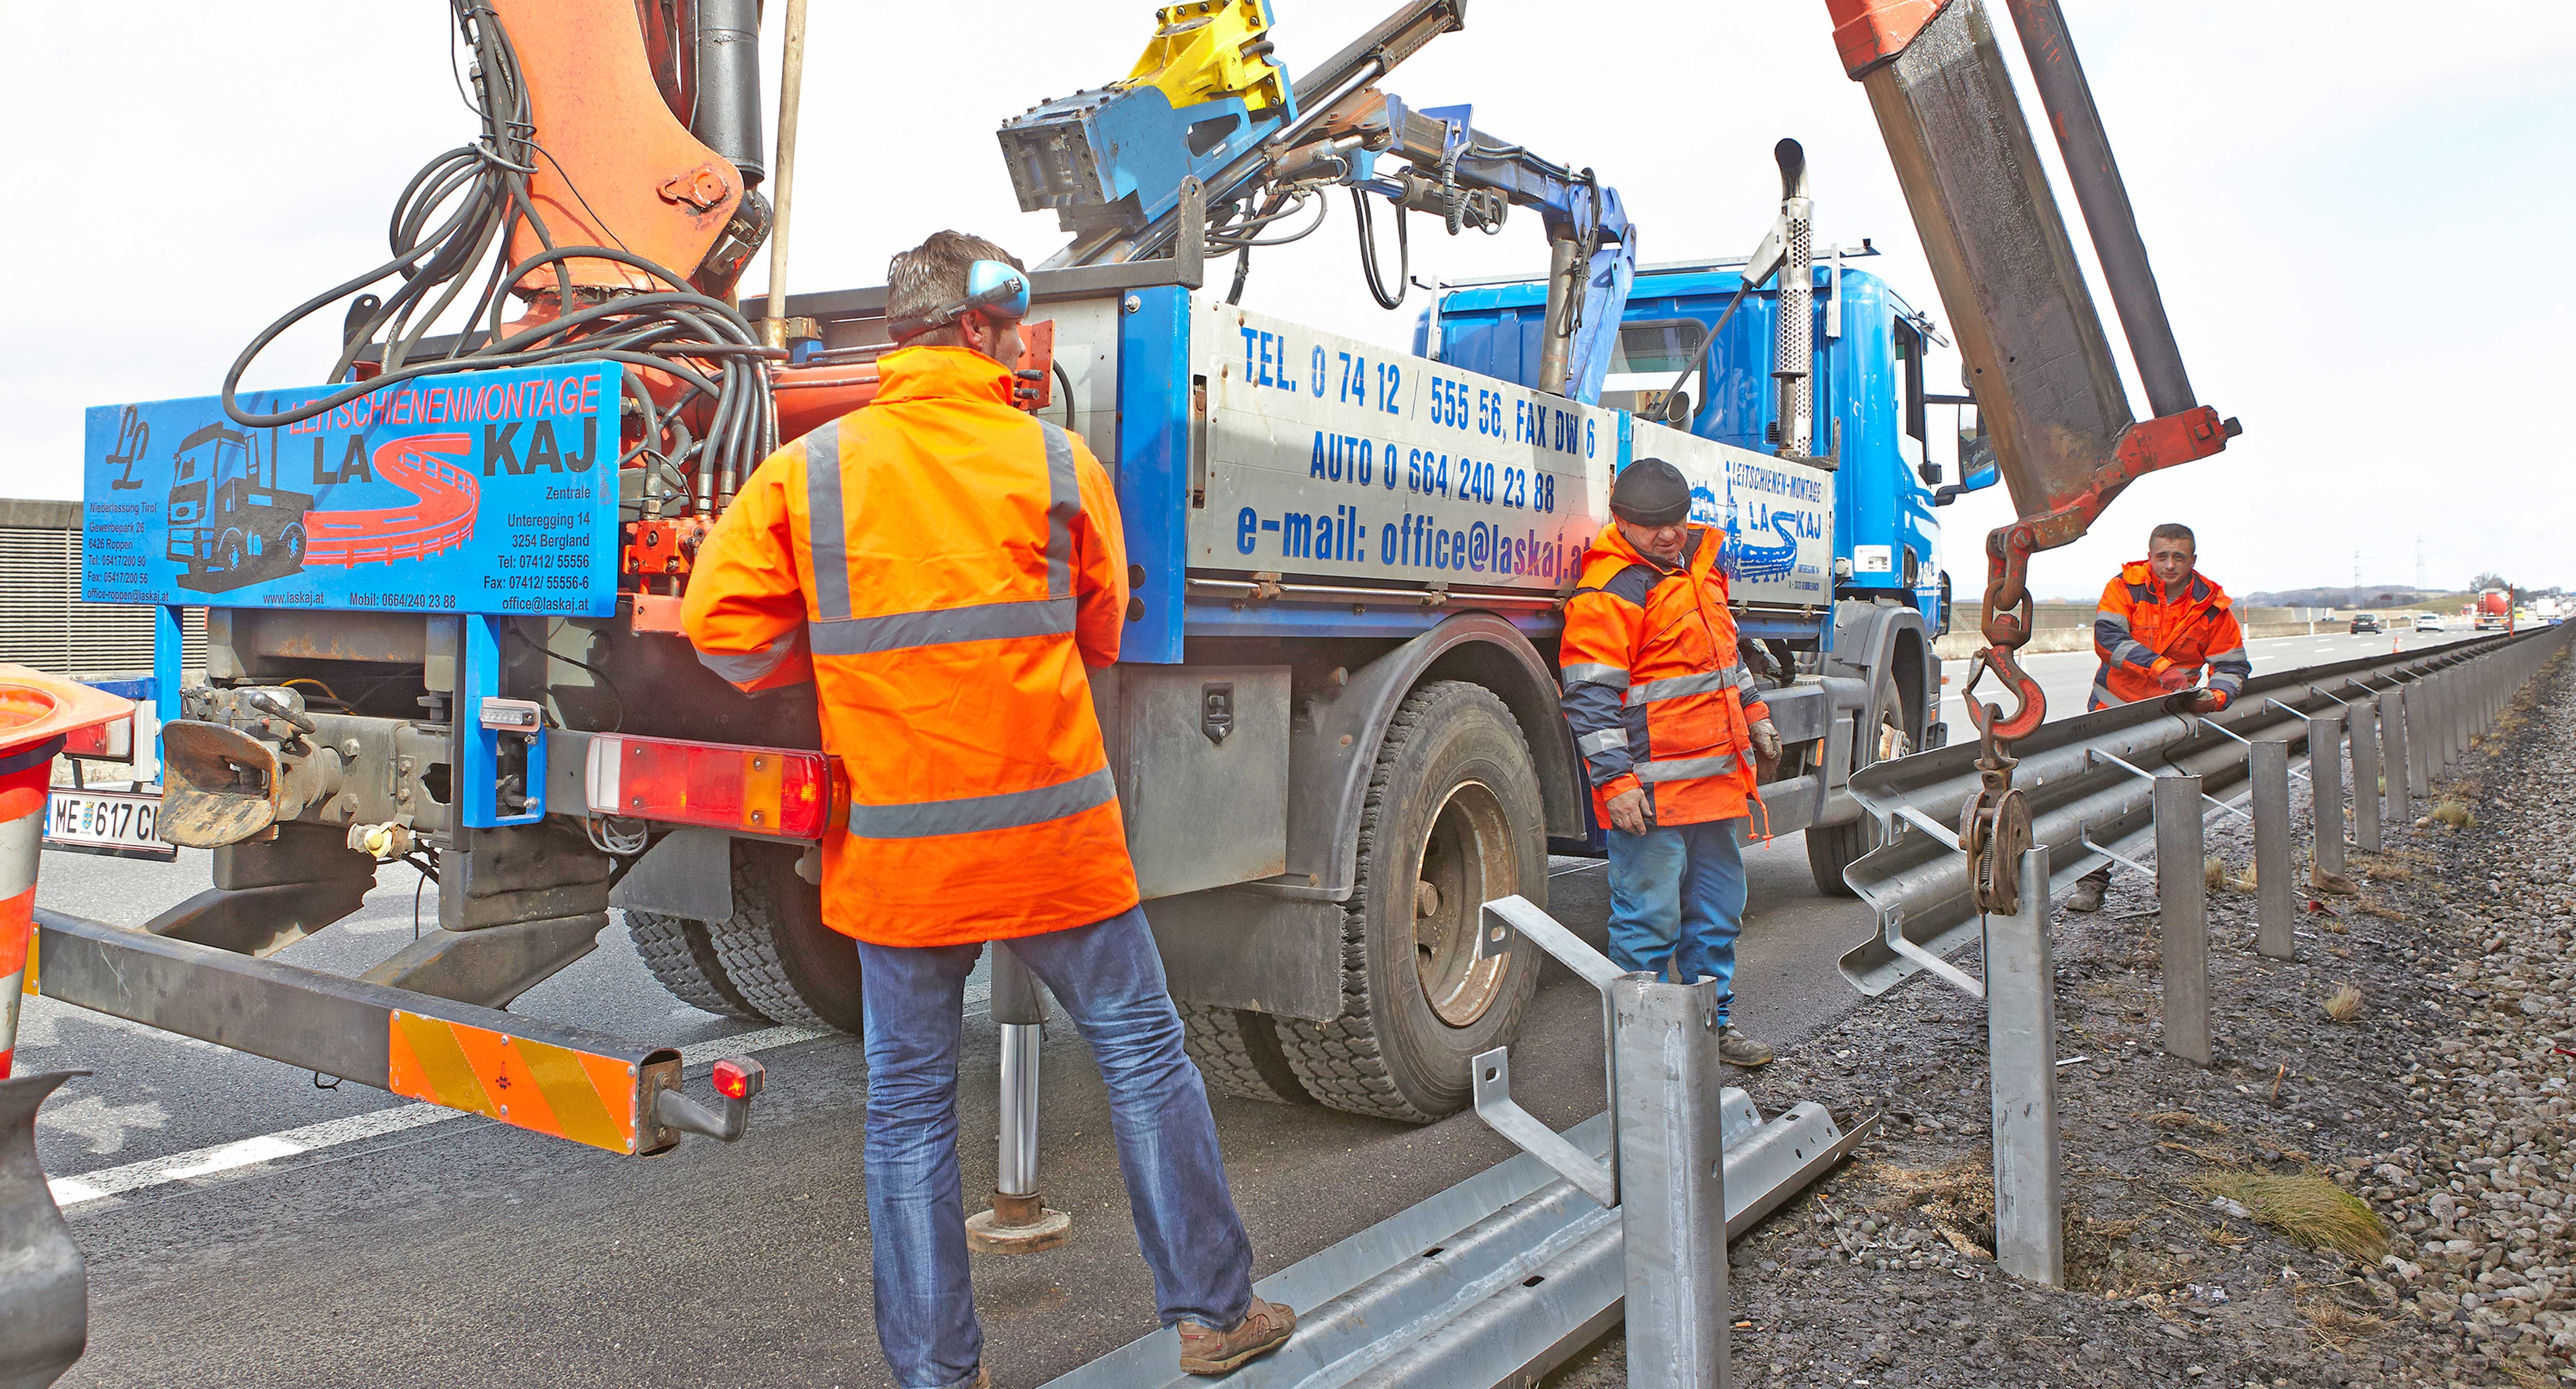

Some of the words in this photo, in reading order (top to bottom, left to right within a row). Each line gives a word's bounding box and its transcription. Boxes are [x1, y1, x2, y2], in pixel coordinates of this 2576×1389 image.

[1241, 327, 1296, 392] TEL.
[1311, 345, 1326, 398] 0
[1340, 351, 1365, 407] 74
[1378, 362, 1400, 415] 12
[1431, 376, 1469, 430] 555
[1479, 389, 1507, 444] 56,
[1516, 399, 1547, 449] FAX
[1555, 409, 1579, 454] DW
[1586, 418, 1595, 459] 6
[1310, 431, 1372, 486] AUTO
[1384, 443, 1397, 490] 0
[1503, 467, 1525, 509] 23
[1534, 473, 1554, 514] 88
[546, 486, 590, 500] Zentrale
[90, 503, 139, 515] Niederlassung
[141, 502, 157, 513] Tirol
[508, 513, 573, 529] Unteregging
[578, 512, 590, 525] 14
[90, 522, 134, 535] Gewerbepark
[136, 522, 145, 533] 26
[1237, 505, 1365, 562] e-mail:
[89, 539, 104, 549] 6426
[106, 539, 133, 552] Roppen
[512, 534, 537, 547] 3254
[540, 534, 589, 550] Bergland
[89, 555, 100, 565] Tel:
[102, 555, 135, 567] 05417/200
[138, 556, 146, 567] 90
[498, 555, 516, 568] Tel:
[520, 555, 554, 568] 07412/
[557, 555, 589, 568] 55556
[88, 571, 101, 582] Fax:
[104, 572, 138, 584] 05417/200
[140, 573, 148, 584] 56
[484, 576, 505, 589] Fax:
[510, 576, 544, 589] 07412/
[547, 576, 589, 589] 55556-6
[87, 588, 169, 603] office-roppen@laskaj.at
[263, 591, 324, 606] www.laskaj.at
[350, 592, 379, 606] Mobil:
[382, 593, 426, 608] 0664/240
[429, 594, 440, 608] 23
[444, 595, 455, 608] 88
[502, 596, 589, 613] office@laskaj.at
[56, 799, 80, 833] ME
[96, 801, 133, 838] 617
